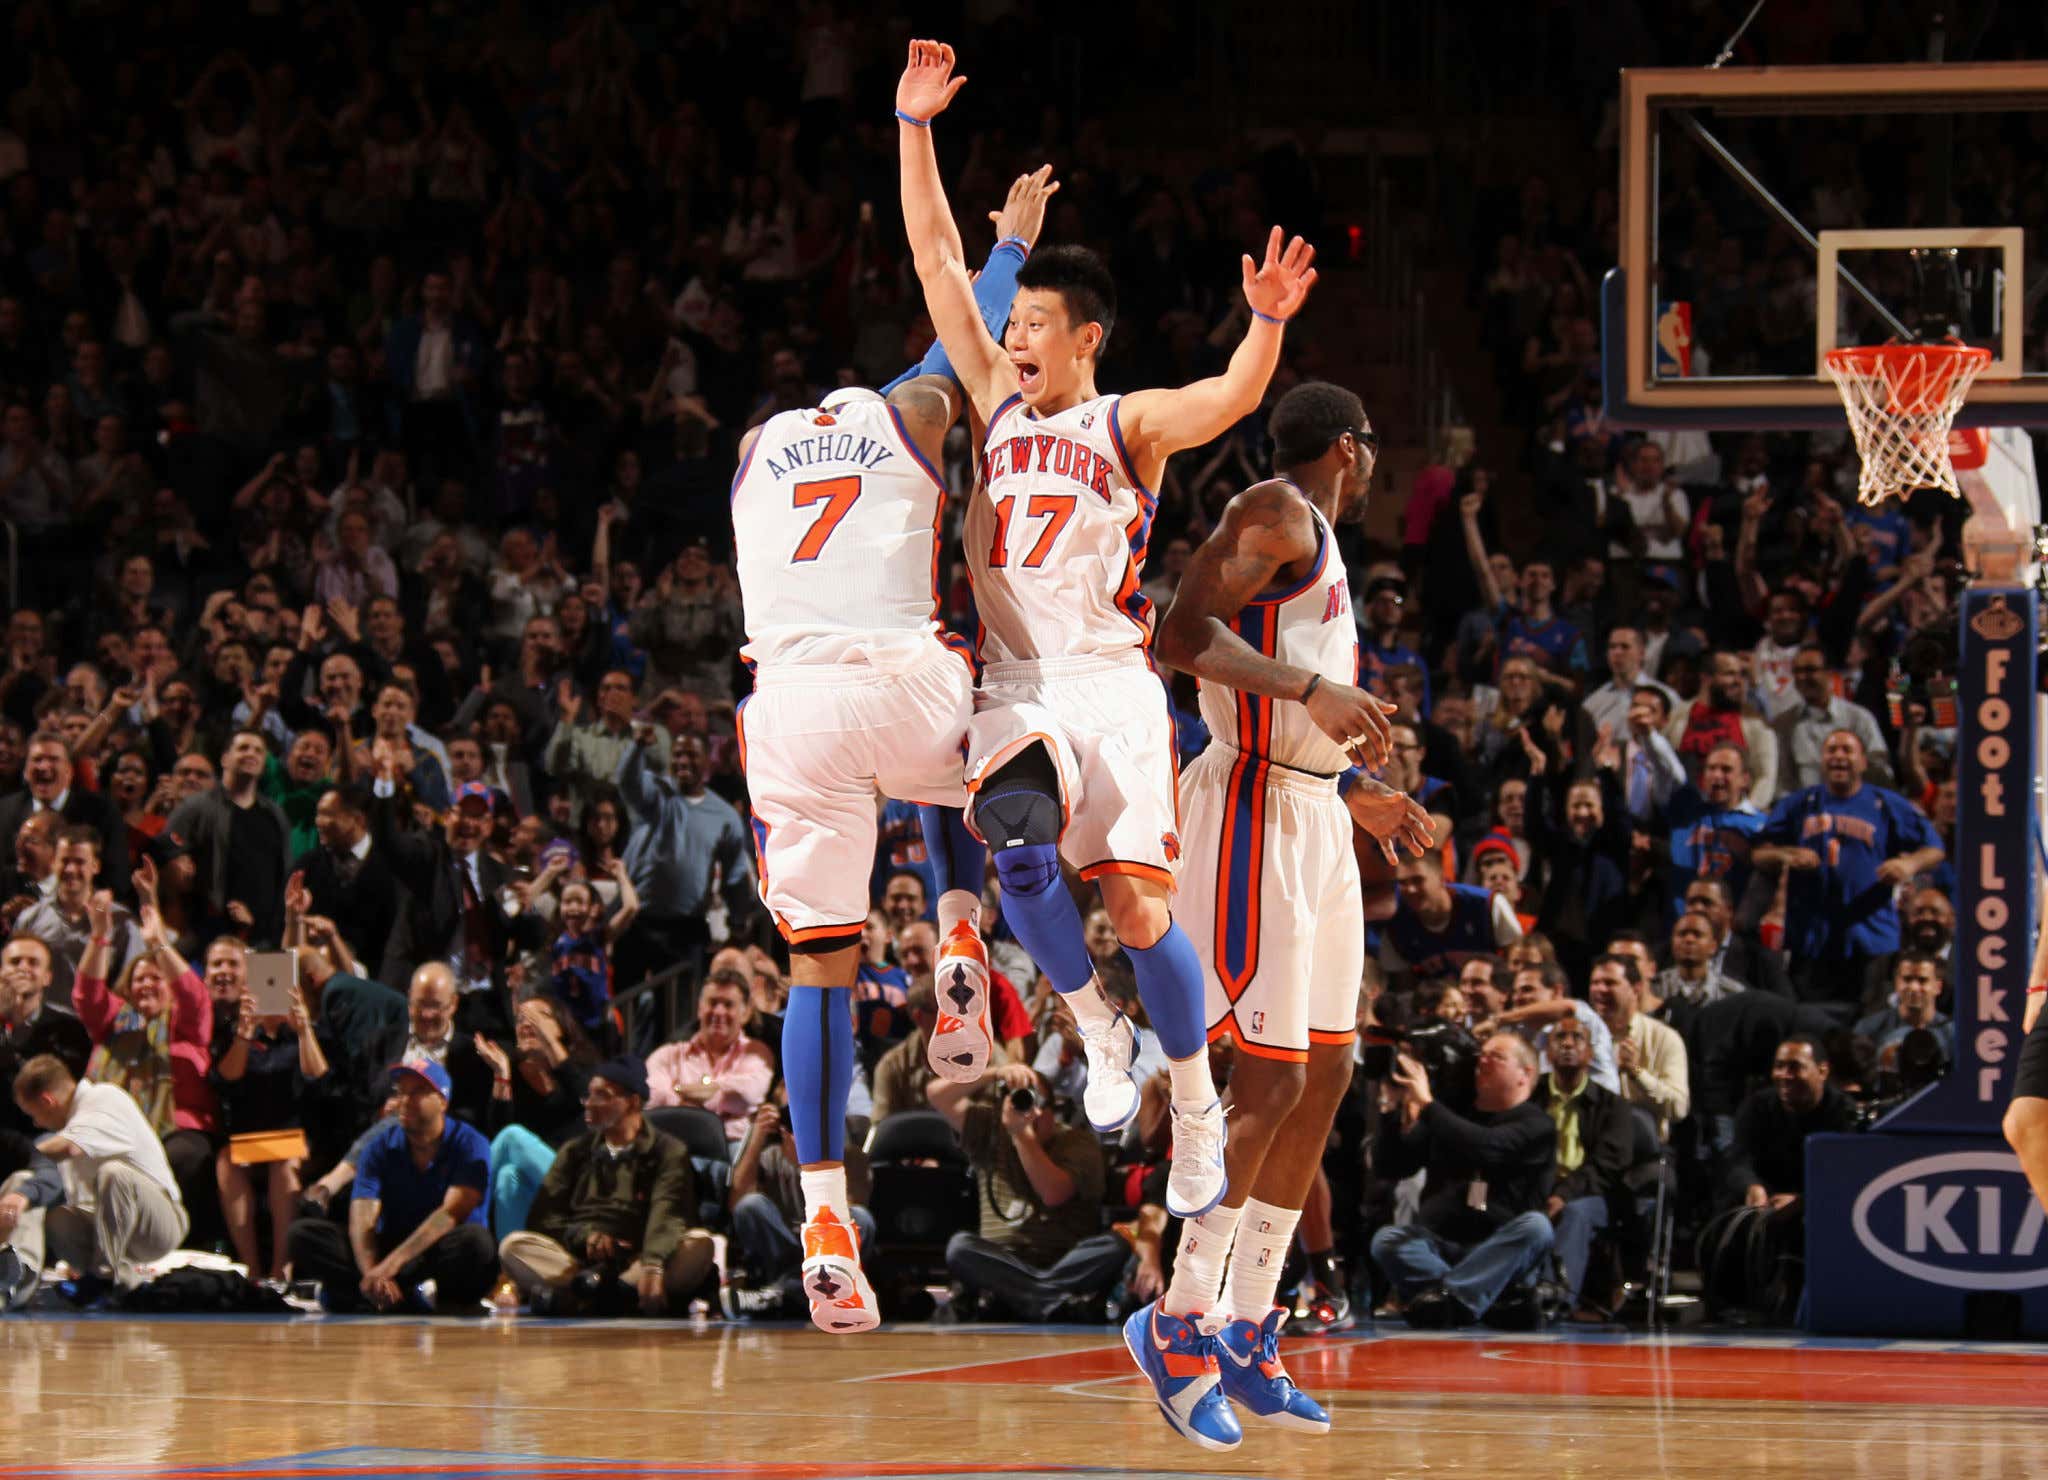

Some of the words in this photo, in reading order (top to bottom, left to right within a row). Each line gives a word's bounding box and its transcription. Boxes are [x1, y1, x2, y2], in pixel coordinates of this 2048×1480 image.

[766, 434, 894, 480] ANTHONY
[791, 475, 862, 564] 7
[989, 495, 1078, 568] 17
[1977, 649, 2012, 816] Foot
[1975, 843, 2010, 1101] Locker
